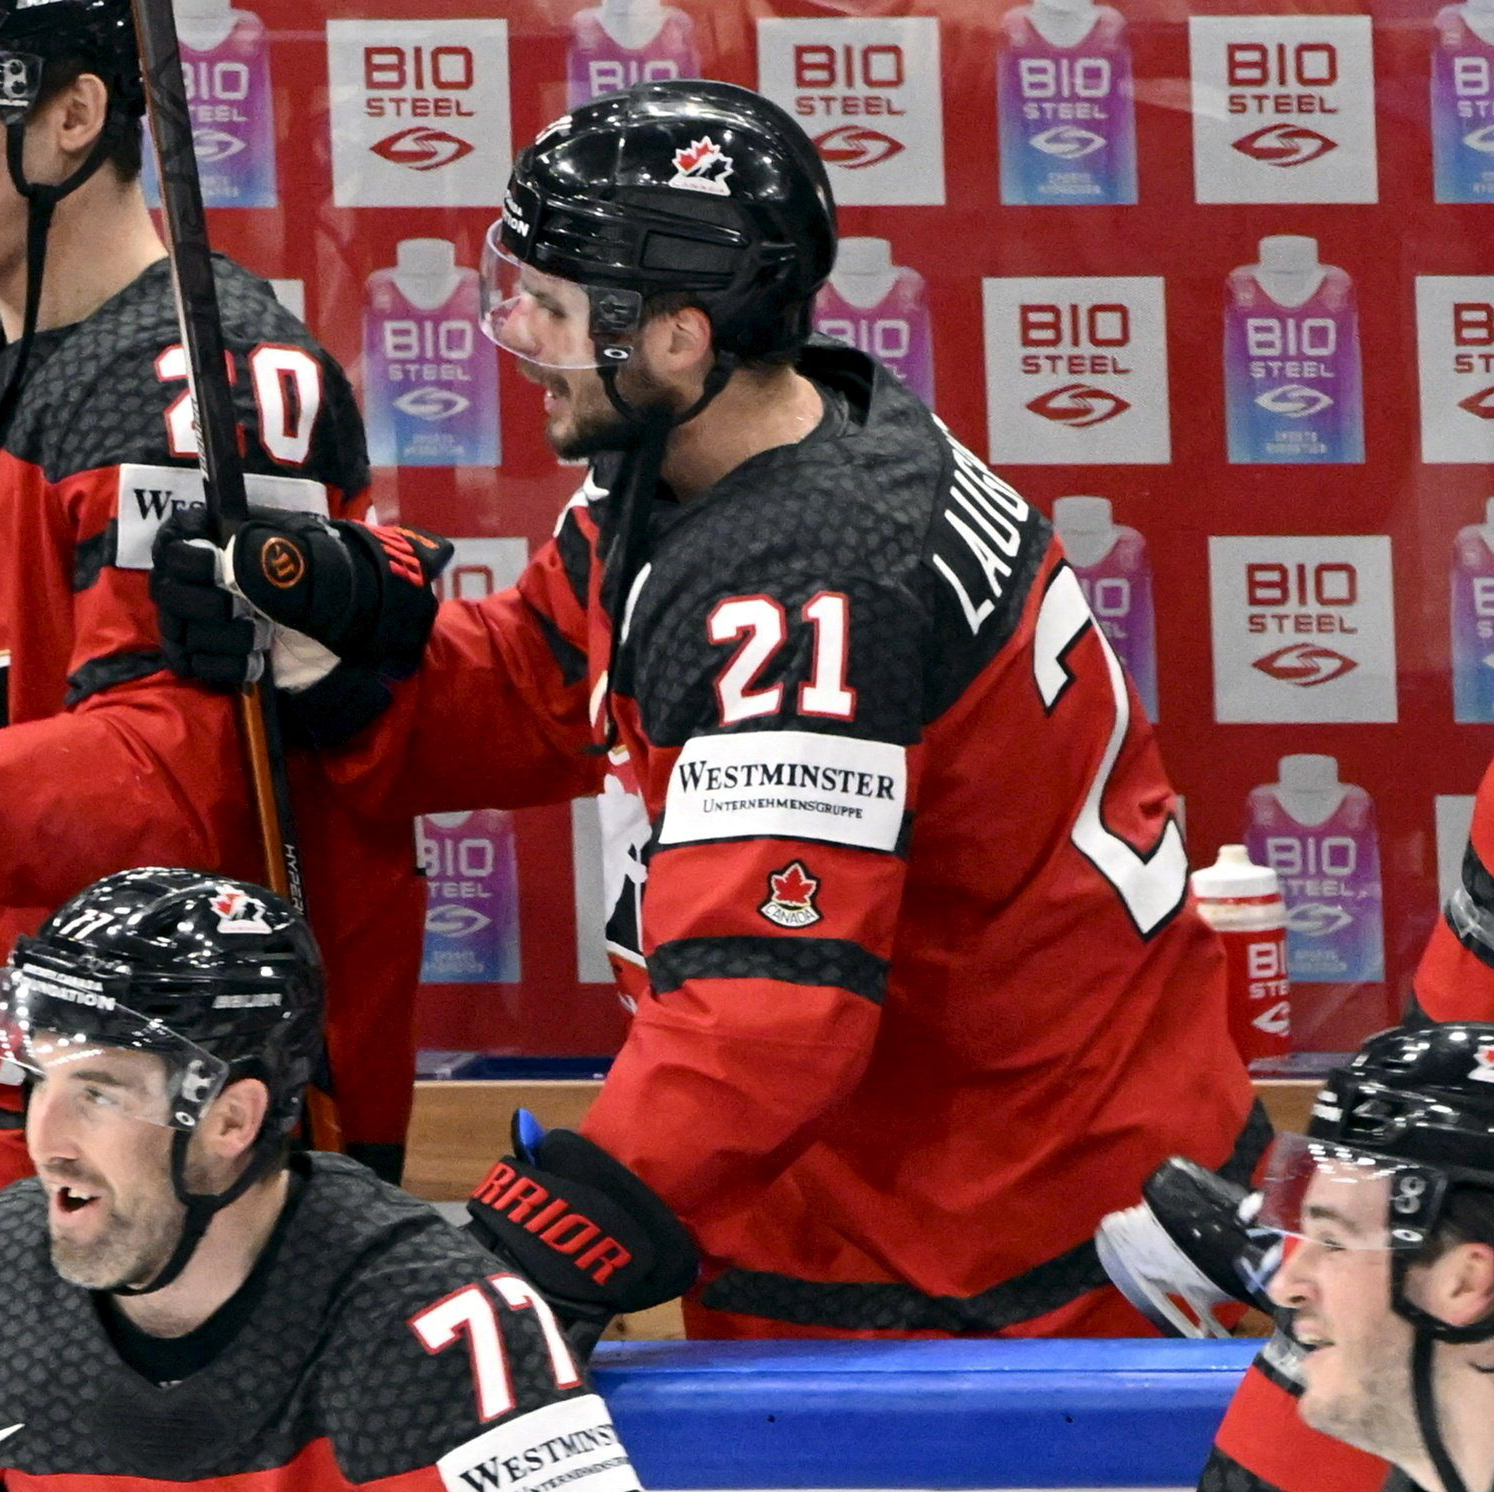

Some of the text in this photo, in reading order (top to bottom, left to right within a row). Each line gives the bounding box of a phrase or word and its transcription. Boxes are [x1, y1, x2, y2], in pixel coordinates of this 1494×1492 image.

[365, 46, 474, 90] BIO
[795, 45, 904, 89] BIO
[1019, 58, 1110, 98] BIO
[1227, 42, 1338, 86] BIO
[366, 97, 475, 118] STEEL
[796, 95, 906, 116] STEEL
[1023, 102, 1109, 119] STEEL
[1228, 92, 1338, 114] STEEL
[385, 320, 473, 360] BIO
[1019, 303, 1130, 348] BIO
[1246, 316, 1336, 357] BIO
[389, 364, 470, 383] STEEL
[1020, 353, 1131, 374] STEEL
[1249, 360, 1334, 378] STEEL
[155, 342, 322, 467] 20
[1246, 563, 1357, 607] BIO
[1248, 612, 1357, 634] STEEL
[710, 591, 857, 725] 21
[679, 761, 895, 801] WESTMINSTER
[703, 798, 864, 821] UNTERNEHMENSGRUPPE
[417, 838, 494, 878] BIO
[1267, 836, 1357, 877] BIO
[765, 903, 815, 923] CANADA
[1249, 942, 1287, 980] BI
[407, 1272, 585, 1425] 77
